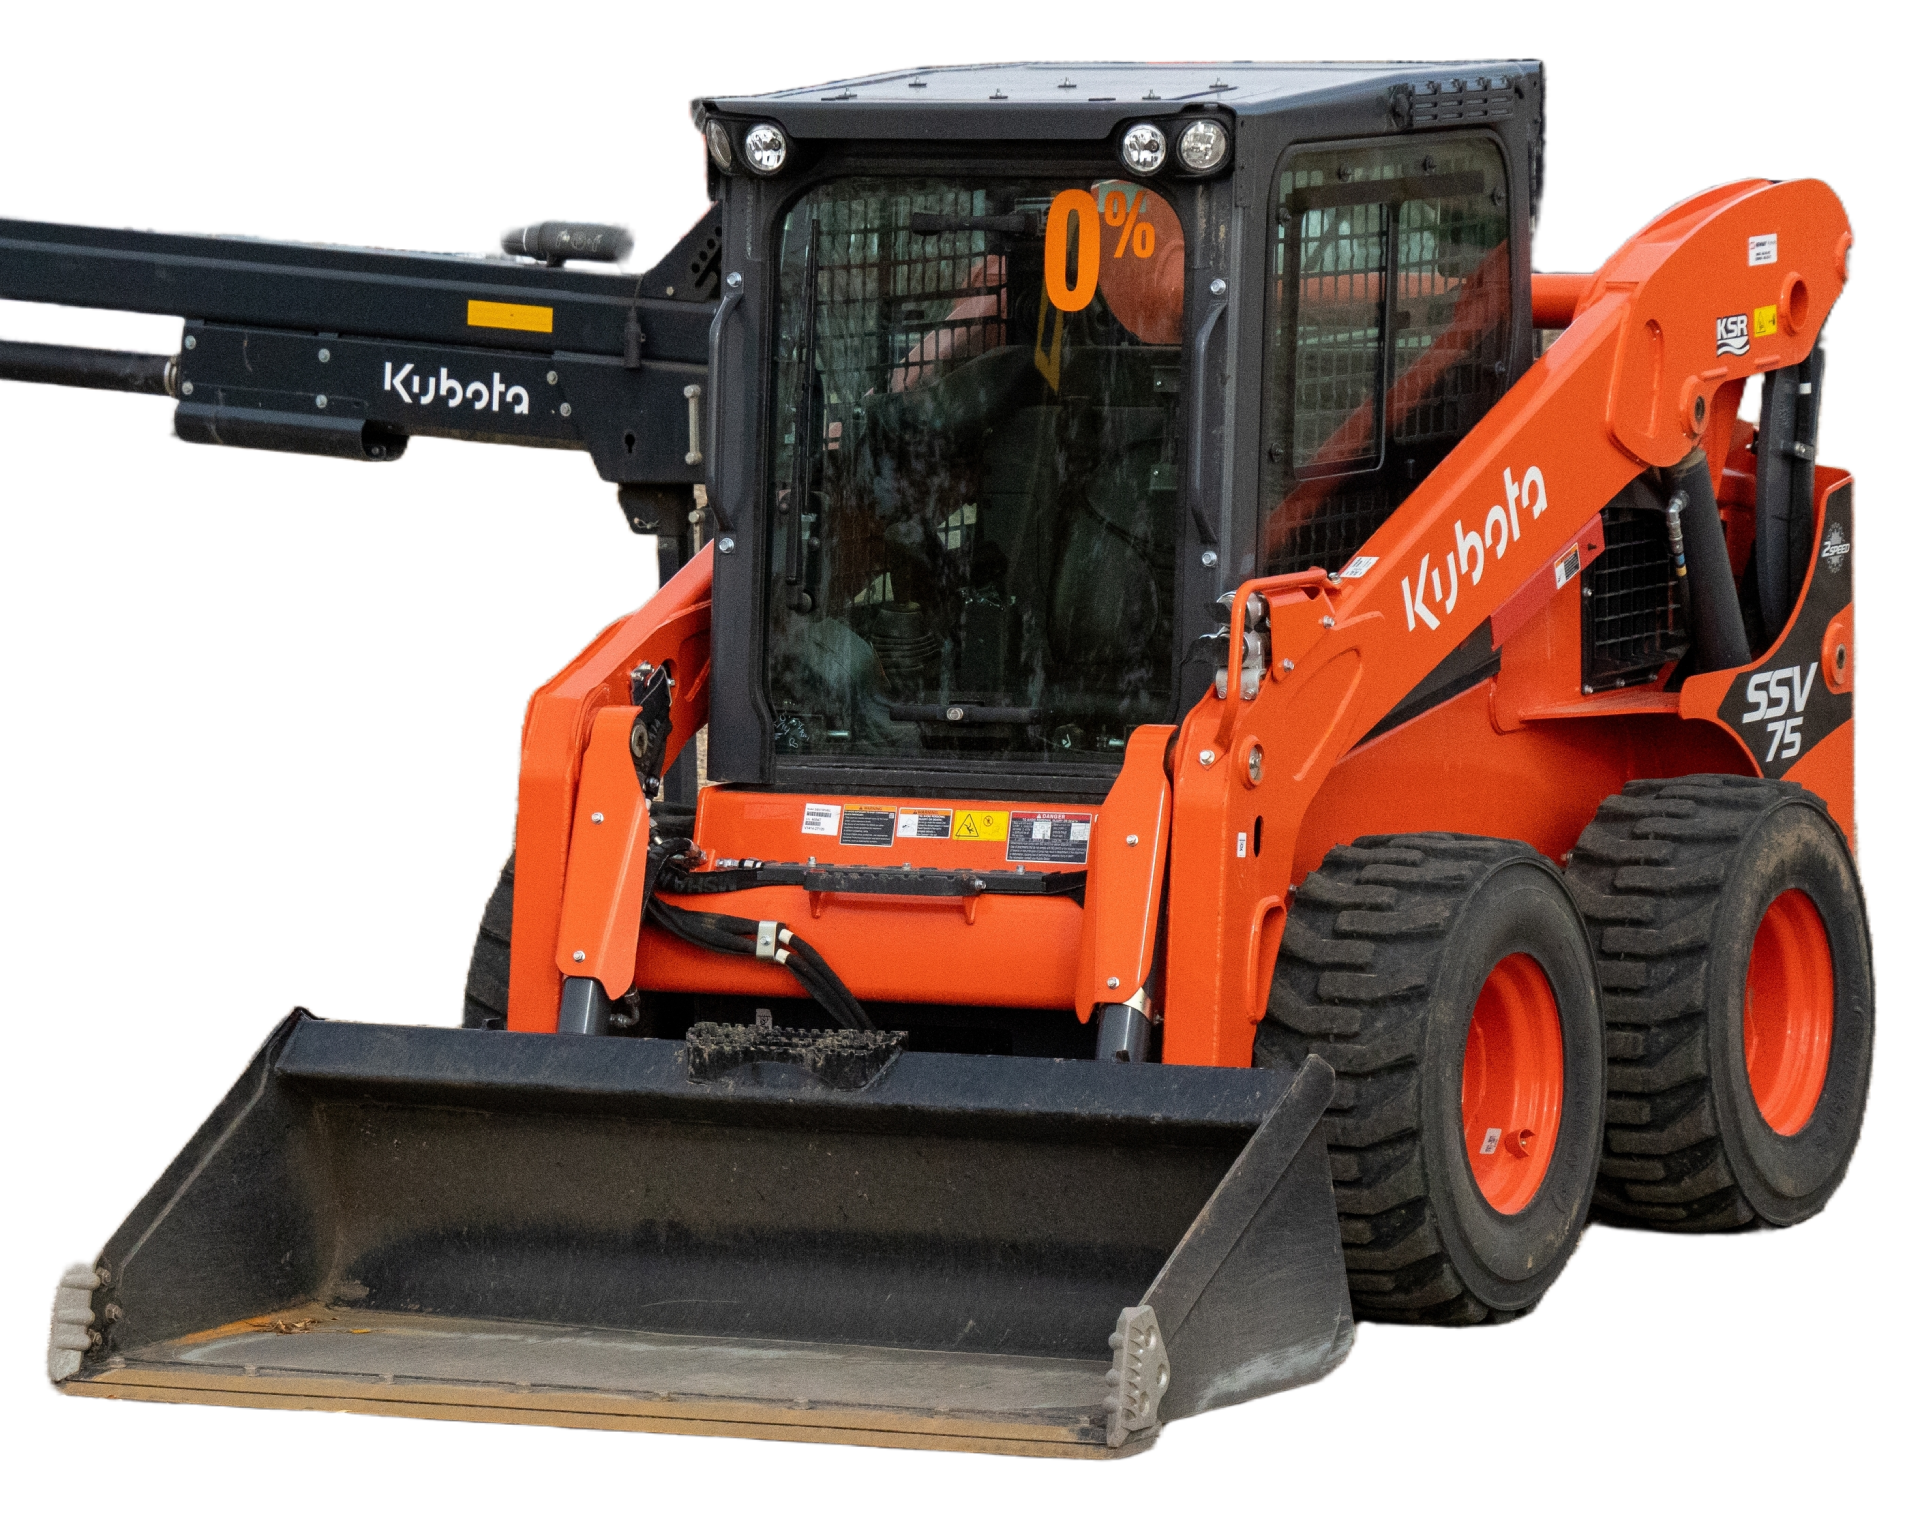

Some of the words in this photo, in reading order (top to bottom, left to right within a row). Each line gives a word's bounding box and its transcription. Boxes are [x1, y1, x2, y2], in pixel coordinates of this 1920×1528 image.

[1044, 188, 1156, 312] 0%
[1717, 314, 1748, 340] KSR
[384, 361, 530, 415] Kubota
[1401, 465, 1548, 632] Kubota
[1742, 661, 1819, 724] SSV
[1765, 716, 1804, 762] 75
